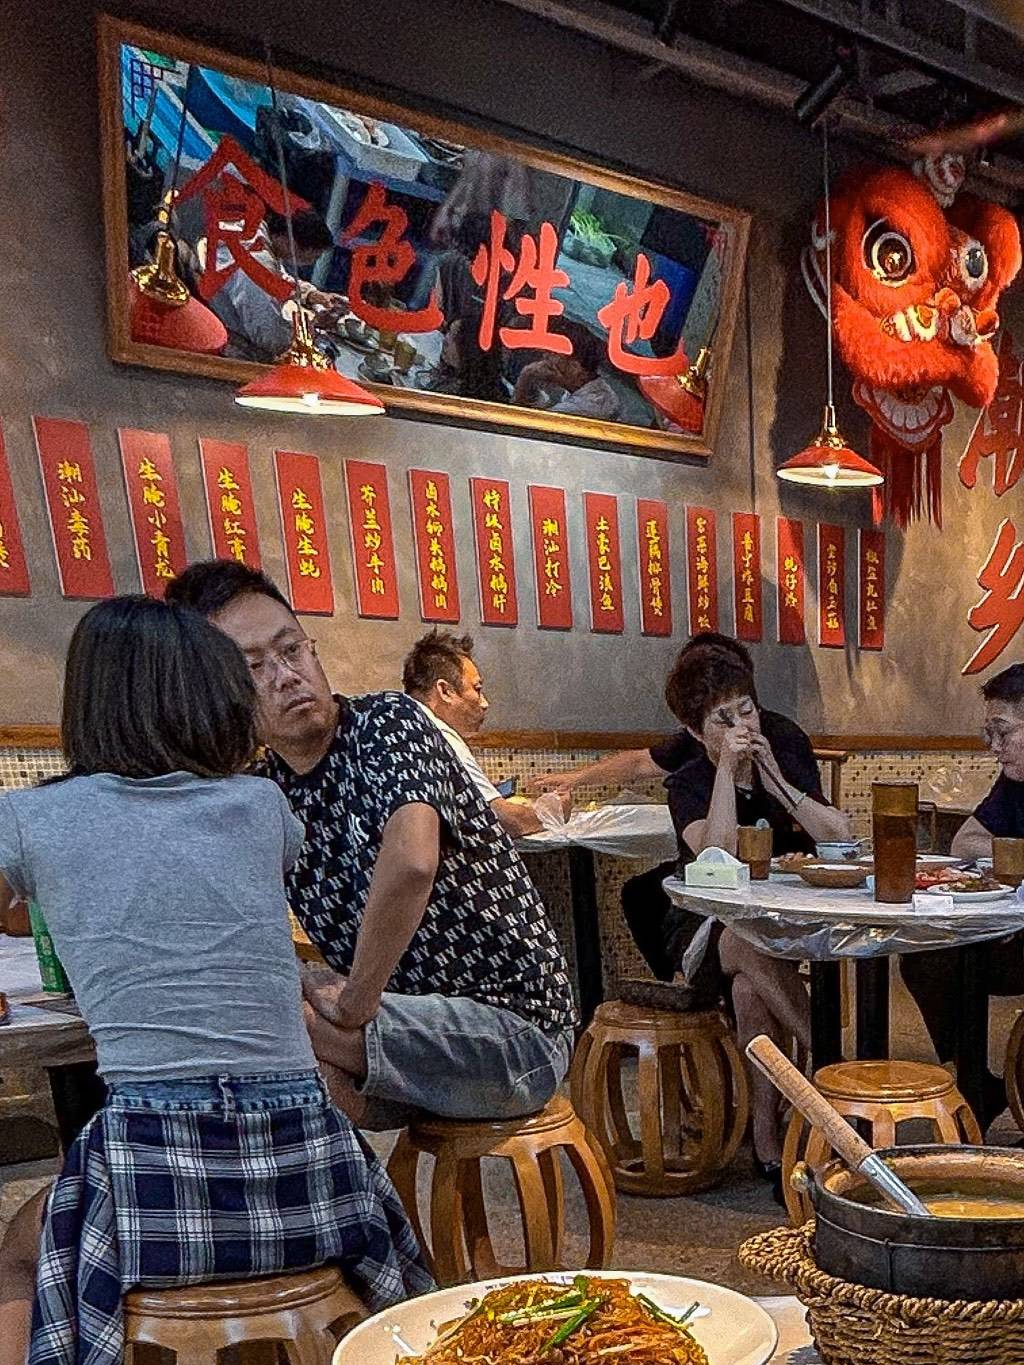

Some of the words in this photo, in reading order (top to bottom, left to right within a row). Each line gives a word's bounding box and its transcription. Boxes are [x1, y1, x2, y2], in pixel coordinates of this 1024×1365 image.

[173, 132, 690, 379] 食色性也
[291, 487, 321, 579] 生腌生蚝
[359, 483, 386, 595] 芥兰炒牛肉
[542, 517, 563, 598] 潮汕打冷
